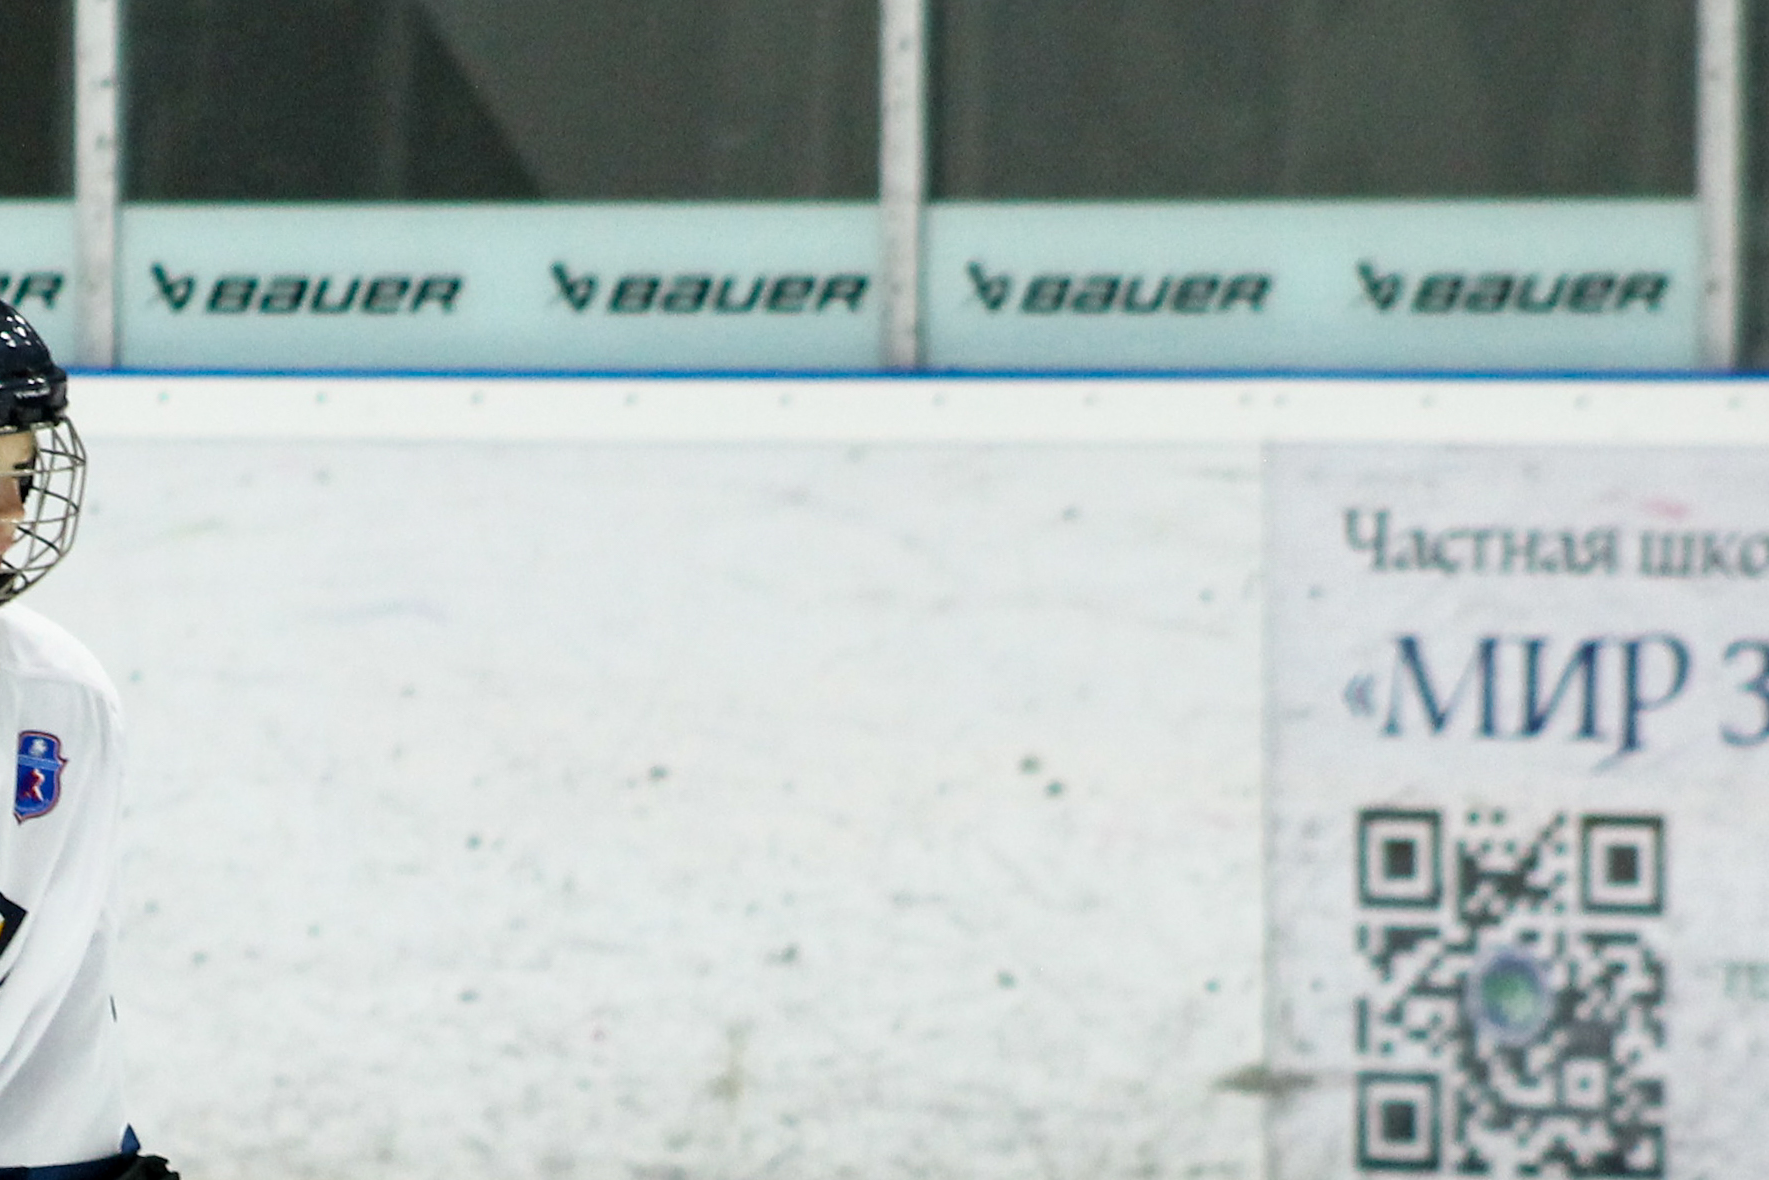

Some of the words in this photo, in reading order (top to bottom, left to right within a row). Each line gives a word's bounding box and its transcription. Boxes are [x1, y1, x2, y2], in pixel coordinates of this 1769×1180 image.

[205, 275, 464, 314] BAUER
[607, 273, 872, 314] BAUER
[1019, 273, 1274, 315] BAUER
[1410, 272, 1670, 314] BAUER
[1342, 506, 1621, 577] Частная
[1342, 633, 1695, 772] «МИР
